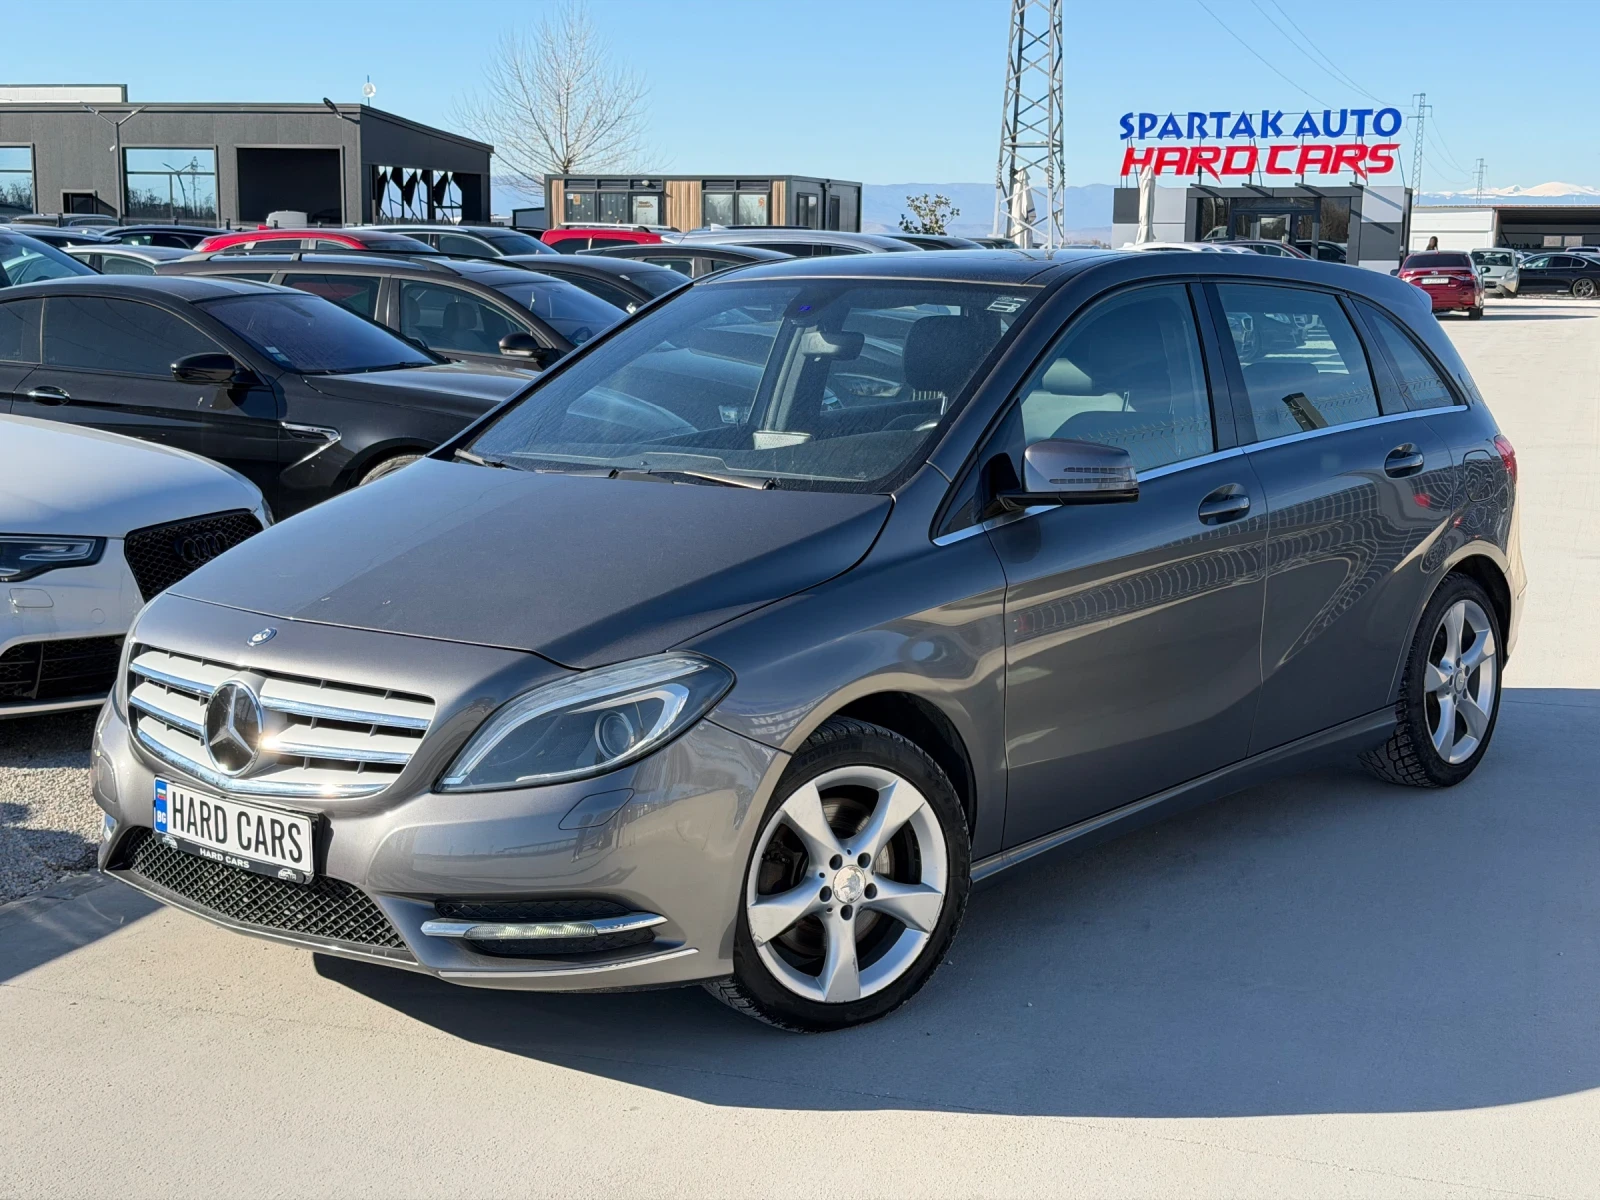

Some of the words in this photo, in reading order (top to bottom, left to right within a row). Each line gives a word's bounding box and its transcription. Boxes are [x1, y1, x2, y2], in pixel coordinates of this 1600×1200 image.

[1119, 110, 1285, 141] SPARTAK
[1292, 107, 1403, 139] AUTO
[1120, 145, 1259, 185] HARD
[1265, 144, 1401, 181] CARS
[157, 810, 167, 824] BG
[172, 791, 228, 844] HARD
[236, 811, 303, 864] CARS
[199, 848, 223, 862] HARD
[225, 856, 250, 869] CARS
